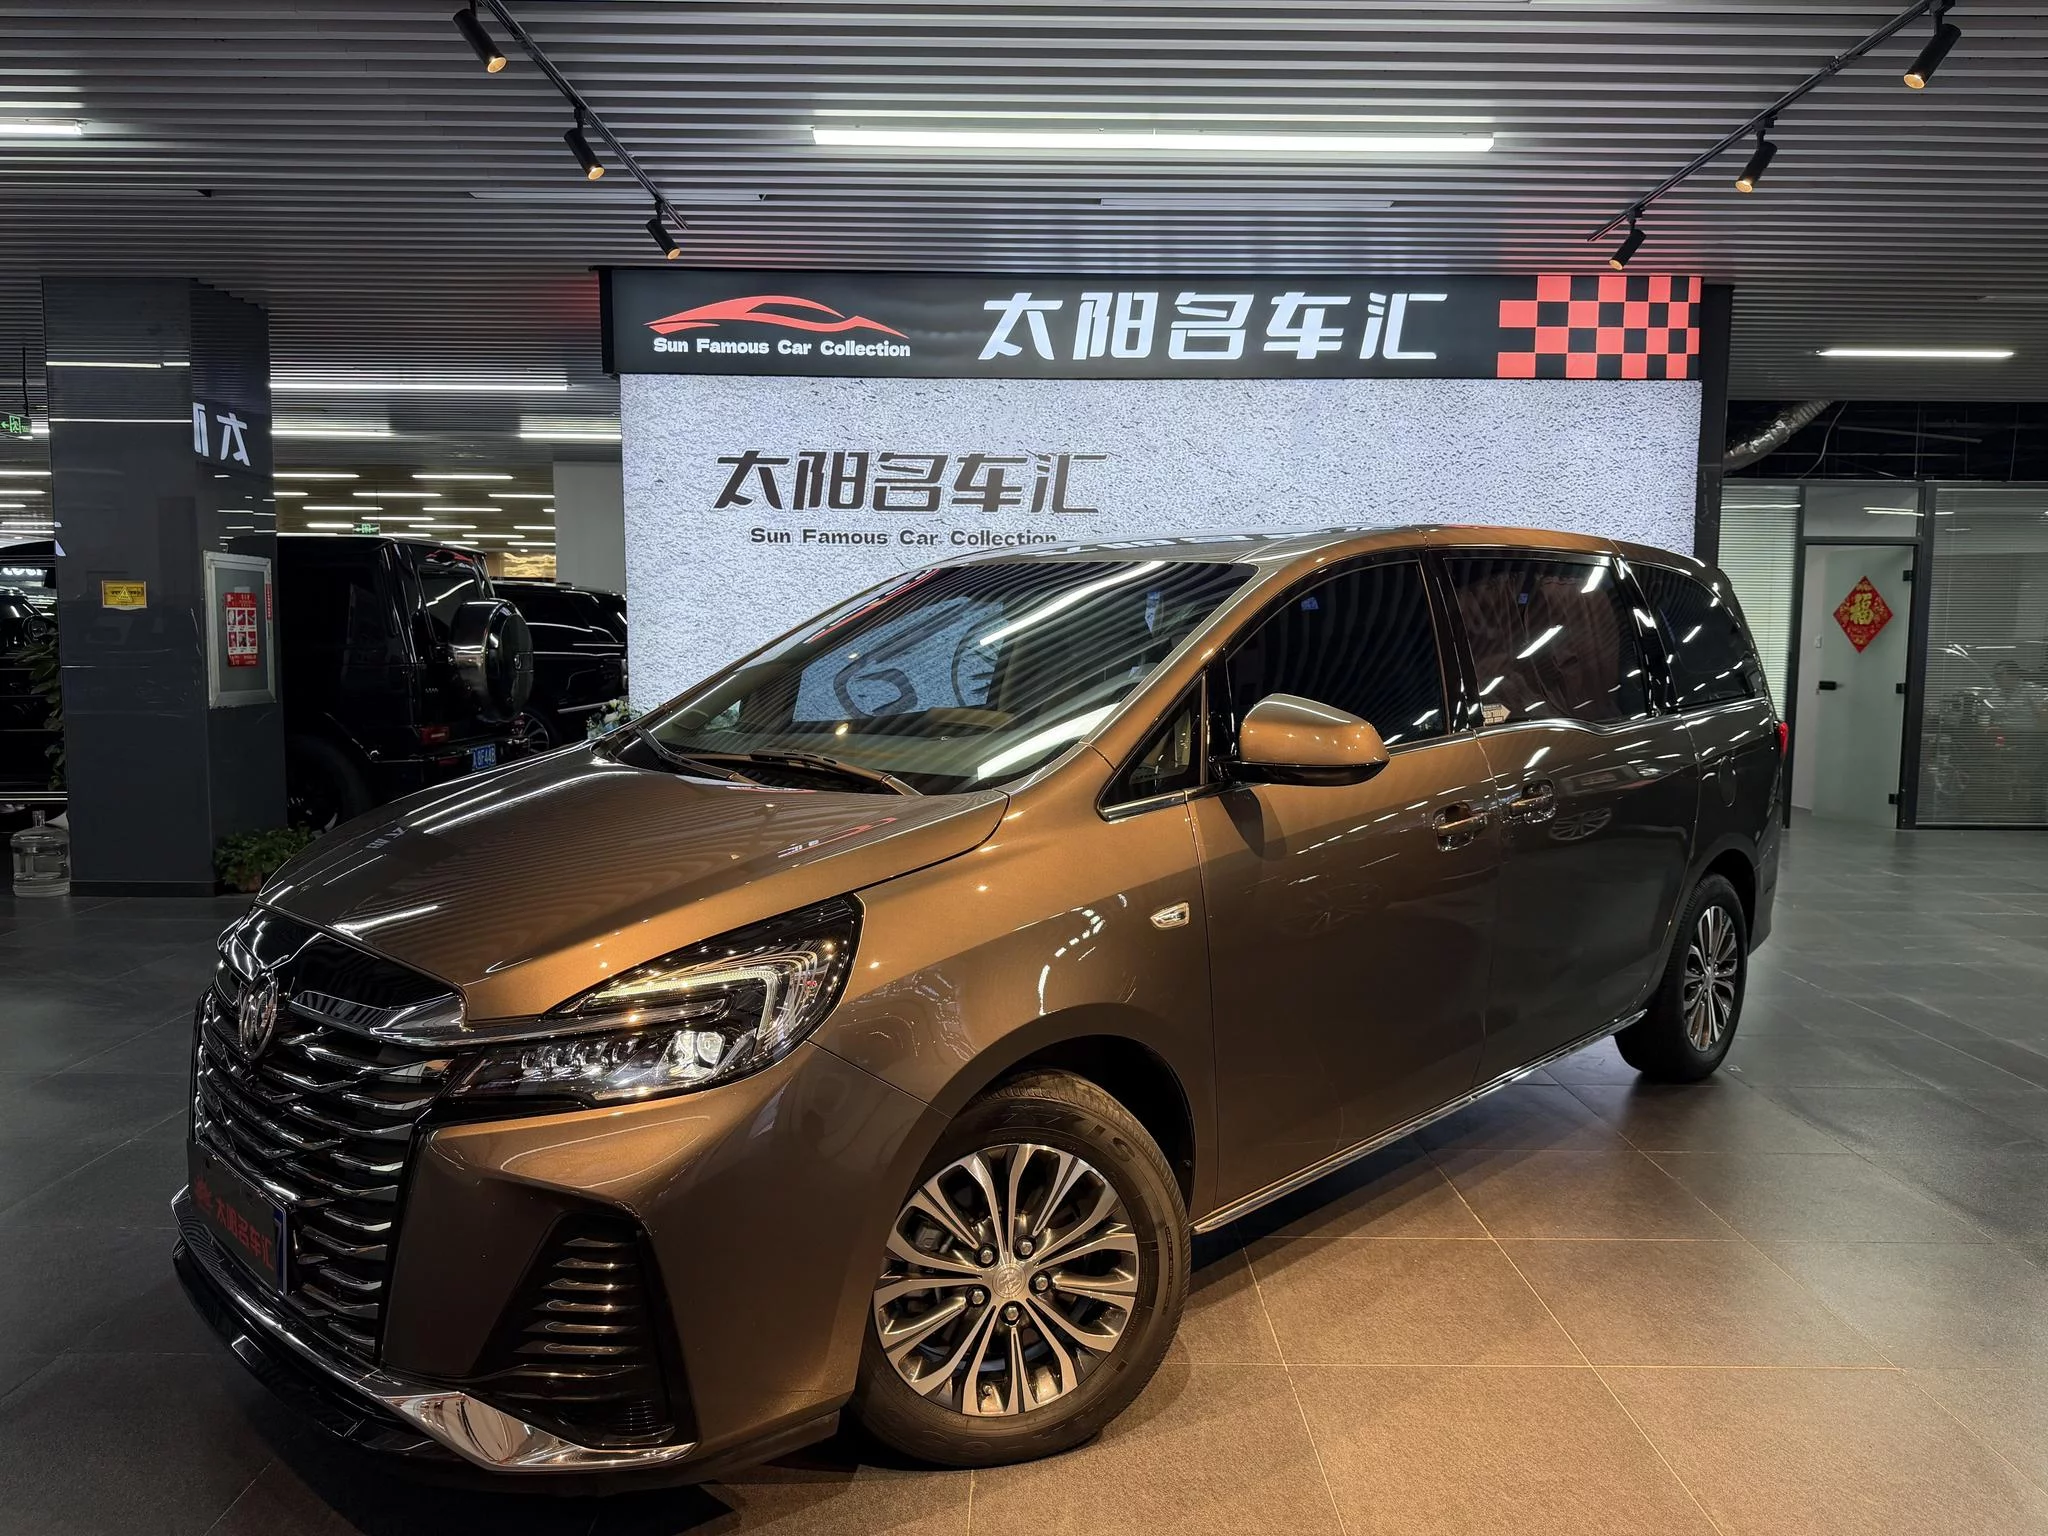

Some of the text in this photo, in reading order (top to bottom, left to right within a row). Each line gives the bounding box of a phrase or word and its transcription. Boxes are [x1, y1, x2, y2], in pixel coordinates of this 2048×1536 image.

[977, 291, 1448, 360] 太阳名车汇
[653, 337, 911, 357] Sun Famous Car Collection
[712, 450, 1109, 514] 太阳名车汇
[750, 528, 792, 545] Sun
[802, 528, 889, 546] Famous
[899, 529, 939, 547] Car
[949, 530, 1058, 547] Collection
[1849, 593, 1874, 625] 福
